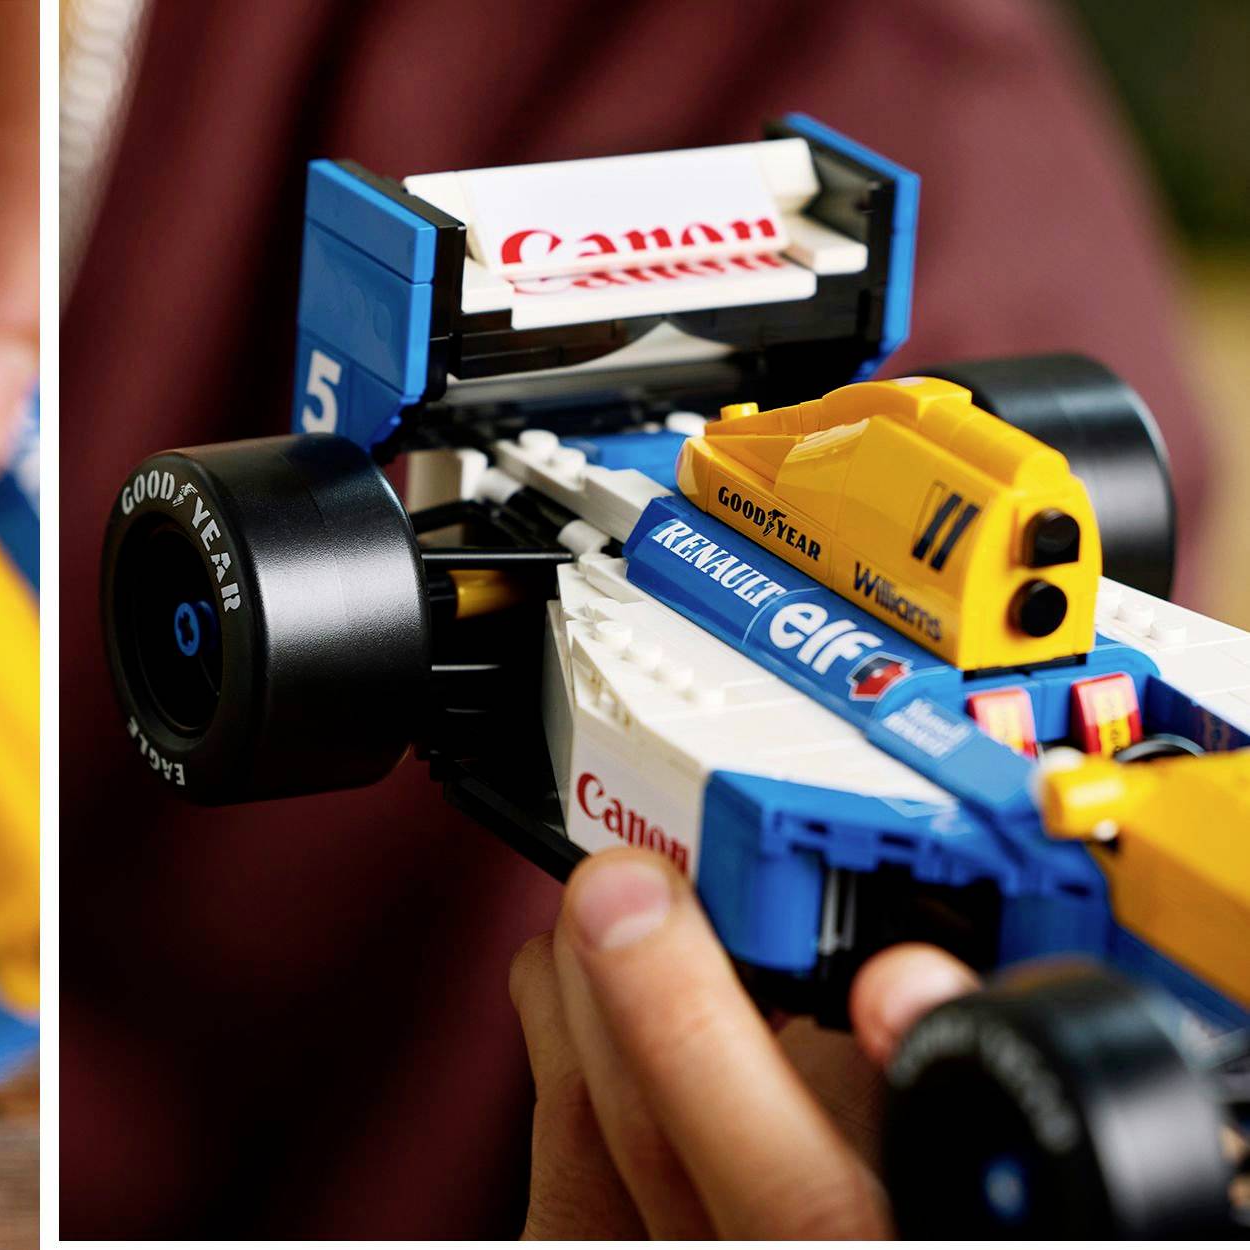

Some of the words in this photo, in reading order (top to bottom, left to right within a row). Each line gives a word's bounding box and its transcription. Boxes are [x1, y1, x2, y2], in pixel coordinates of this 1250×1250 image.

[500, 217, 784, 294] Canon
[301, 350, 342, 433] 5
[652, 520, 787, 607] RENAULT
[853, 561, 943, 642] Williams
[769, 603, 883, 675] elf
[126, 716, 185, 786] EAGLE
[577, 773, 689, 877] Canon
